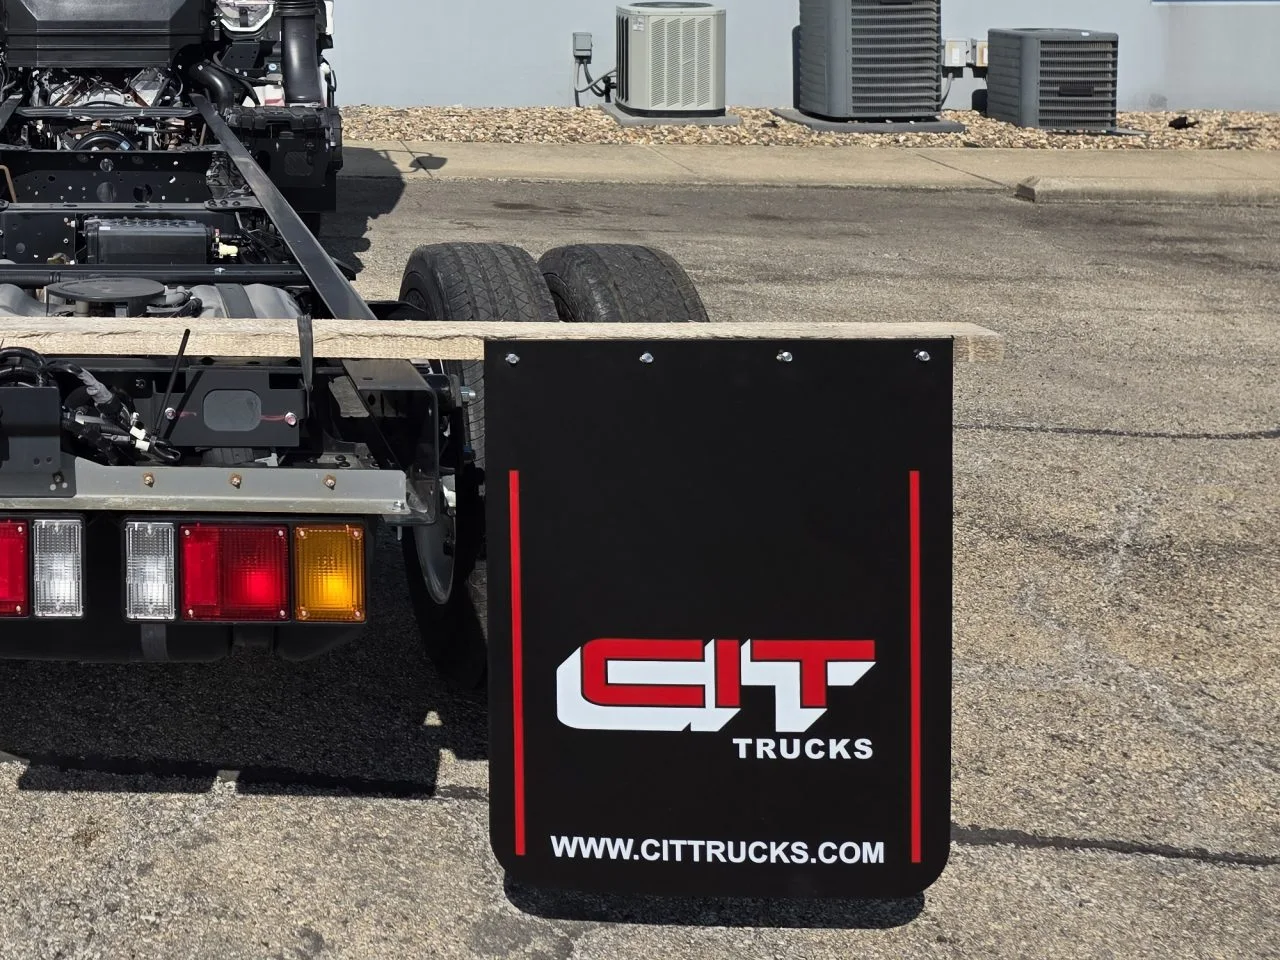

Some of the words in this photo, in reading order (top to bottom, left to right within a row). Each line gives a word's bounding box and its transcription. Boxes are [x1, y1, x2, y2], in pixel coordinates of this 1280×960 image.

[556, 638, 876, 732] CIT
[732, 738, 874, 760] TRUCKS
[550, 835, 886, 864] WWW.CITTRUCKS.COM
